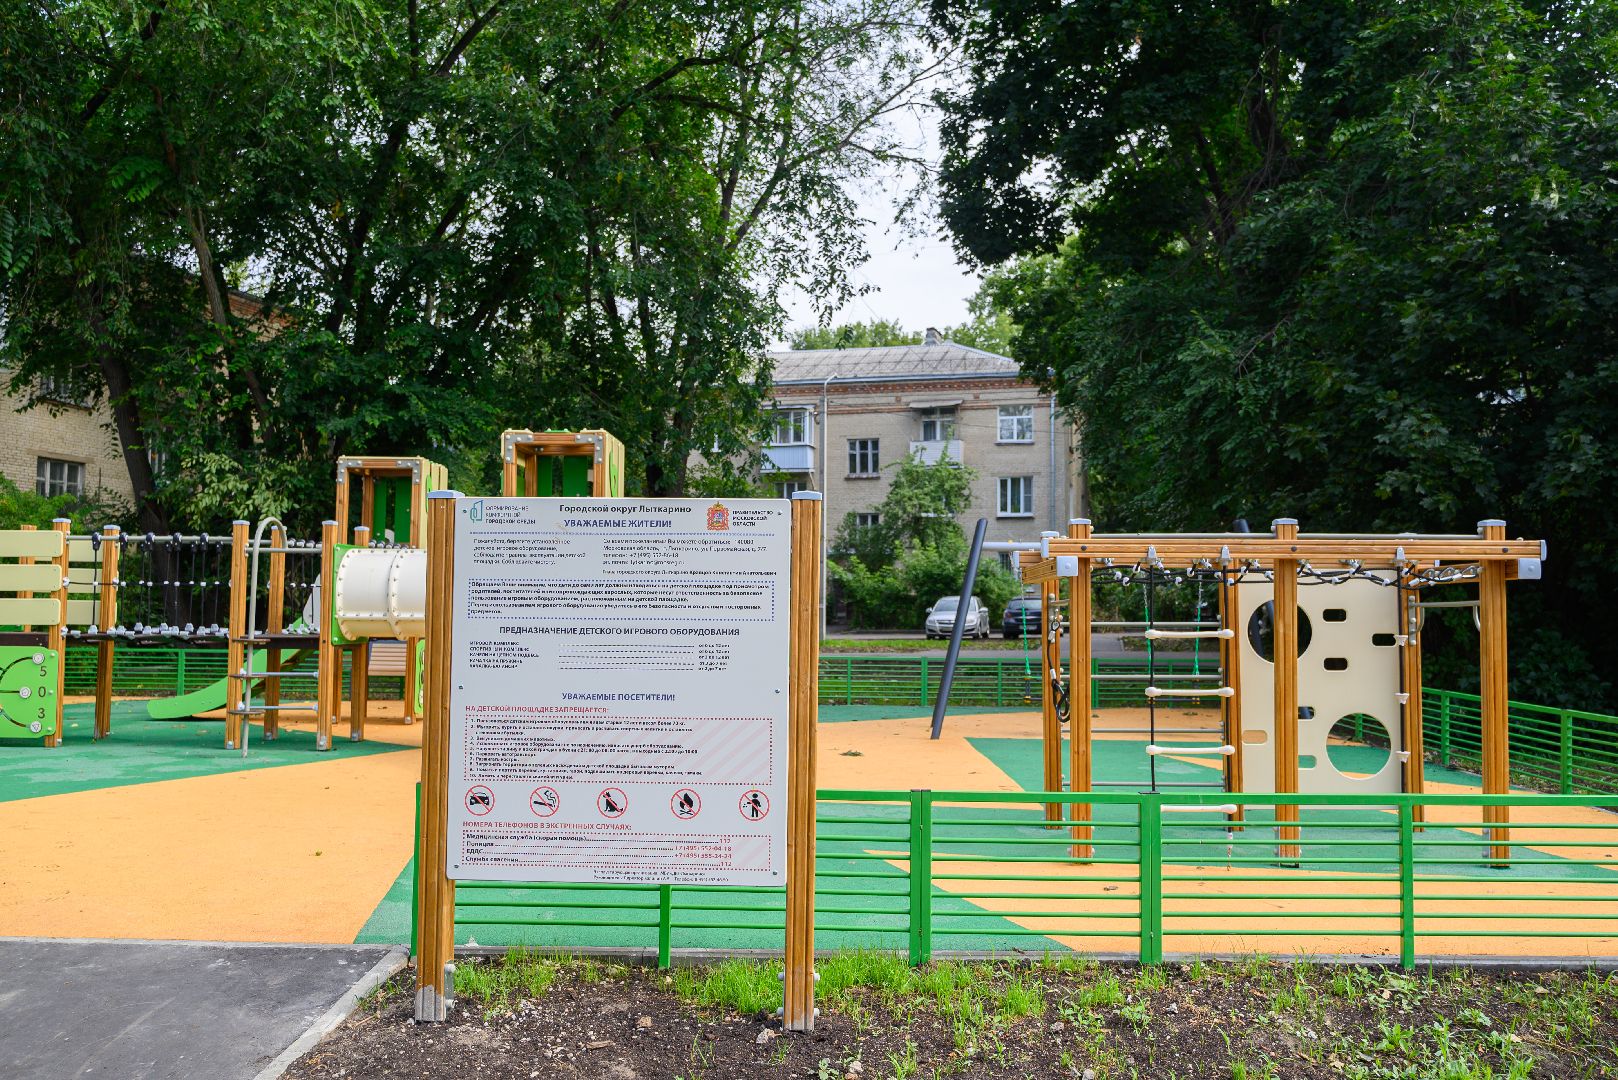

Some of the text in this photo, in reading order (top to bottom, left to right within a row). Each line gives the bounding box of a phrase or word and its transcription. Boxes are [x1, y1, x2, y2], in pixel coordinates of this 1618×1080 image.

[559, 504, 692, 514] Городской округ Лыткарино
[563, 520, 627, 528] УВАЖАЕМЫЕ
[499, 626, 578, 635] ПРЕДНАЗНАЧЕНИЕ
[578, 627, 622, 636] ДЕТСКОГО
[670, 628, 740, 636] ОБОРУДОВАНИЯ
[39, 665, 47, 677] 5
[562, 693, 675, 701] УВАЖАЕМЫЕ ПОСЕТИТЕЛИ!
[38, 707, 46, 719] 3
[477, 705, 511, 713] ДЕТСКОЙ
